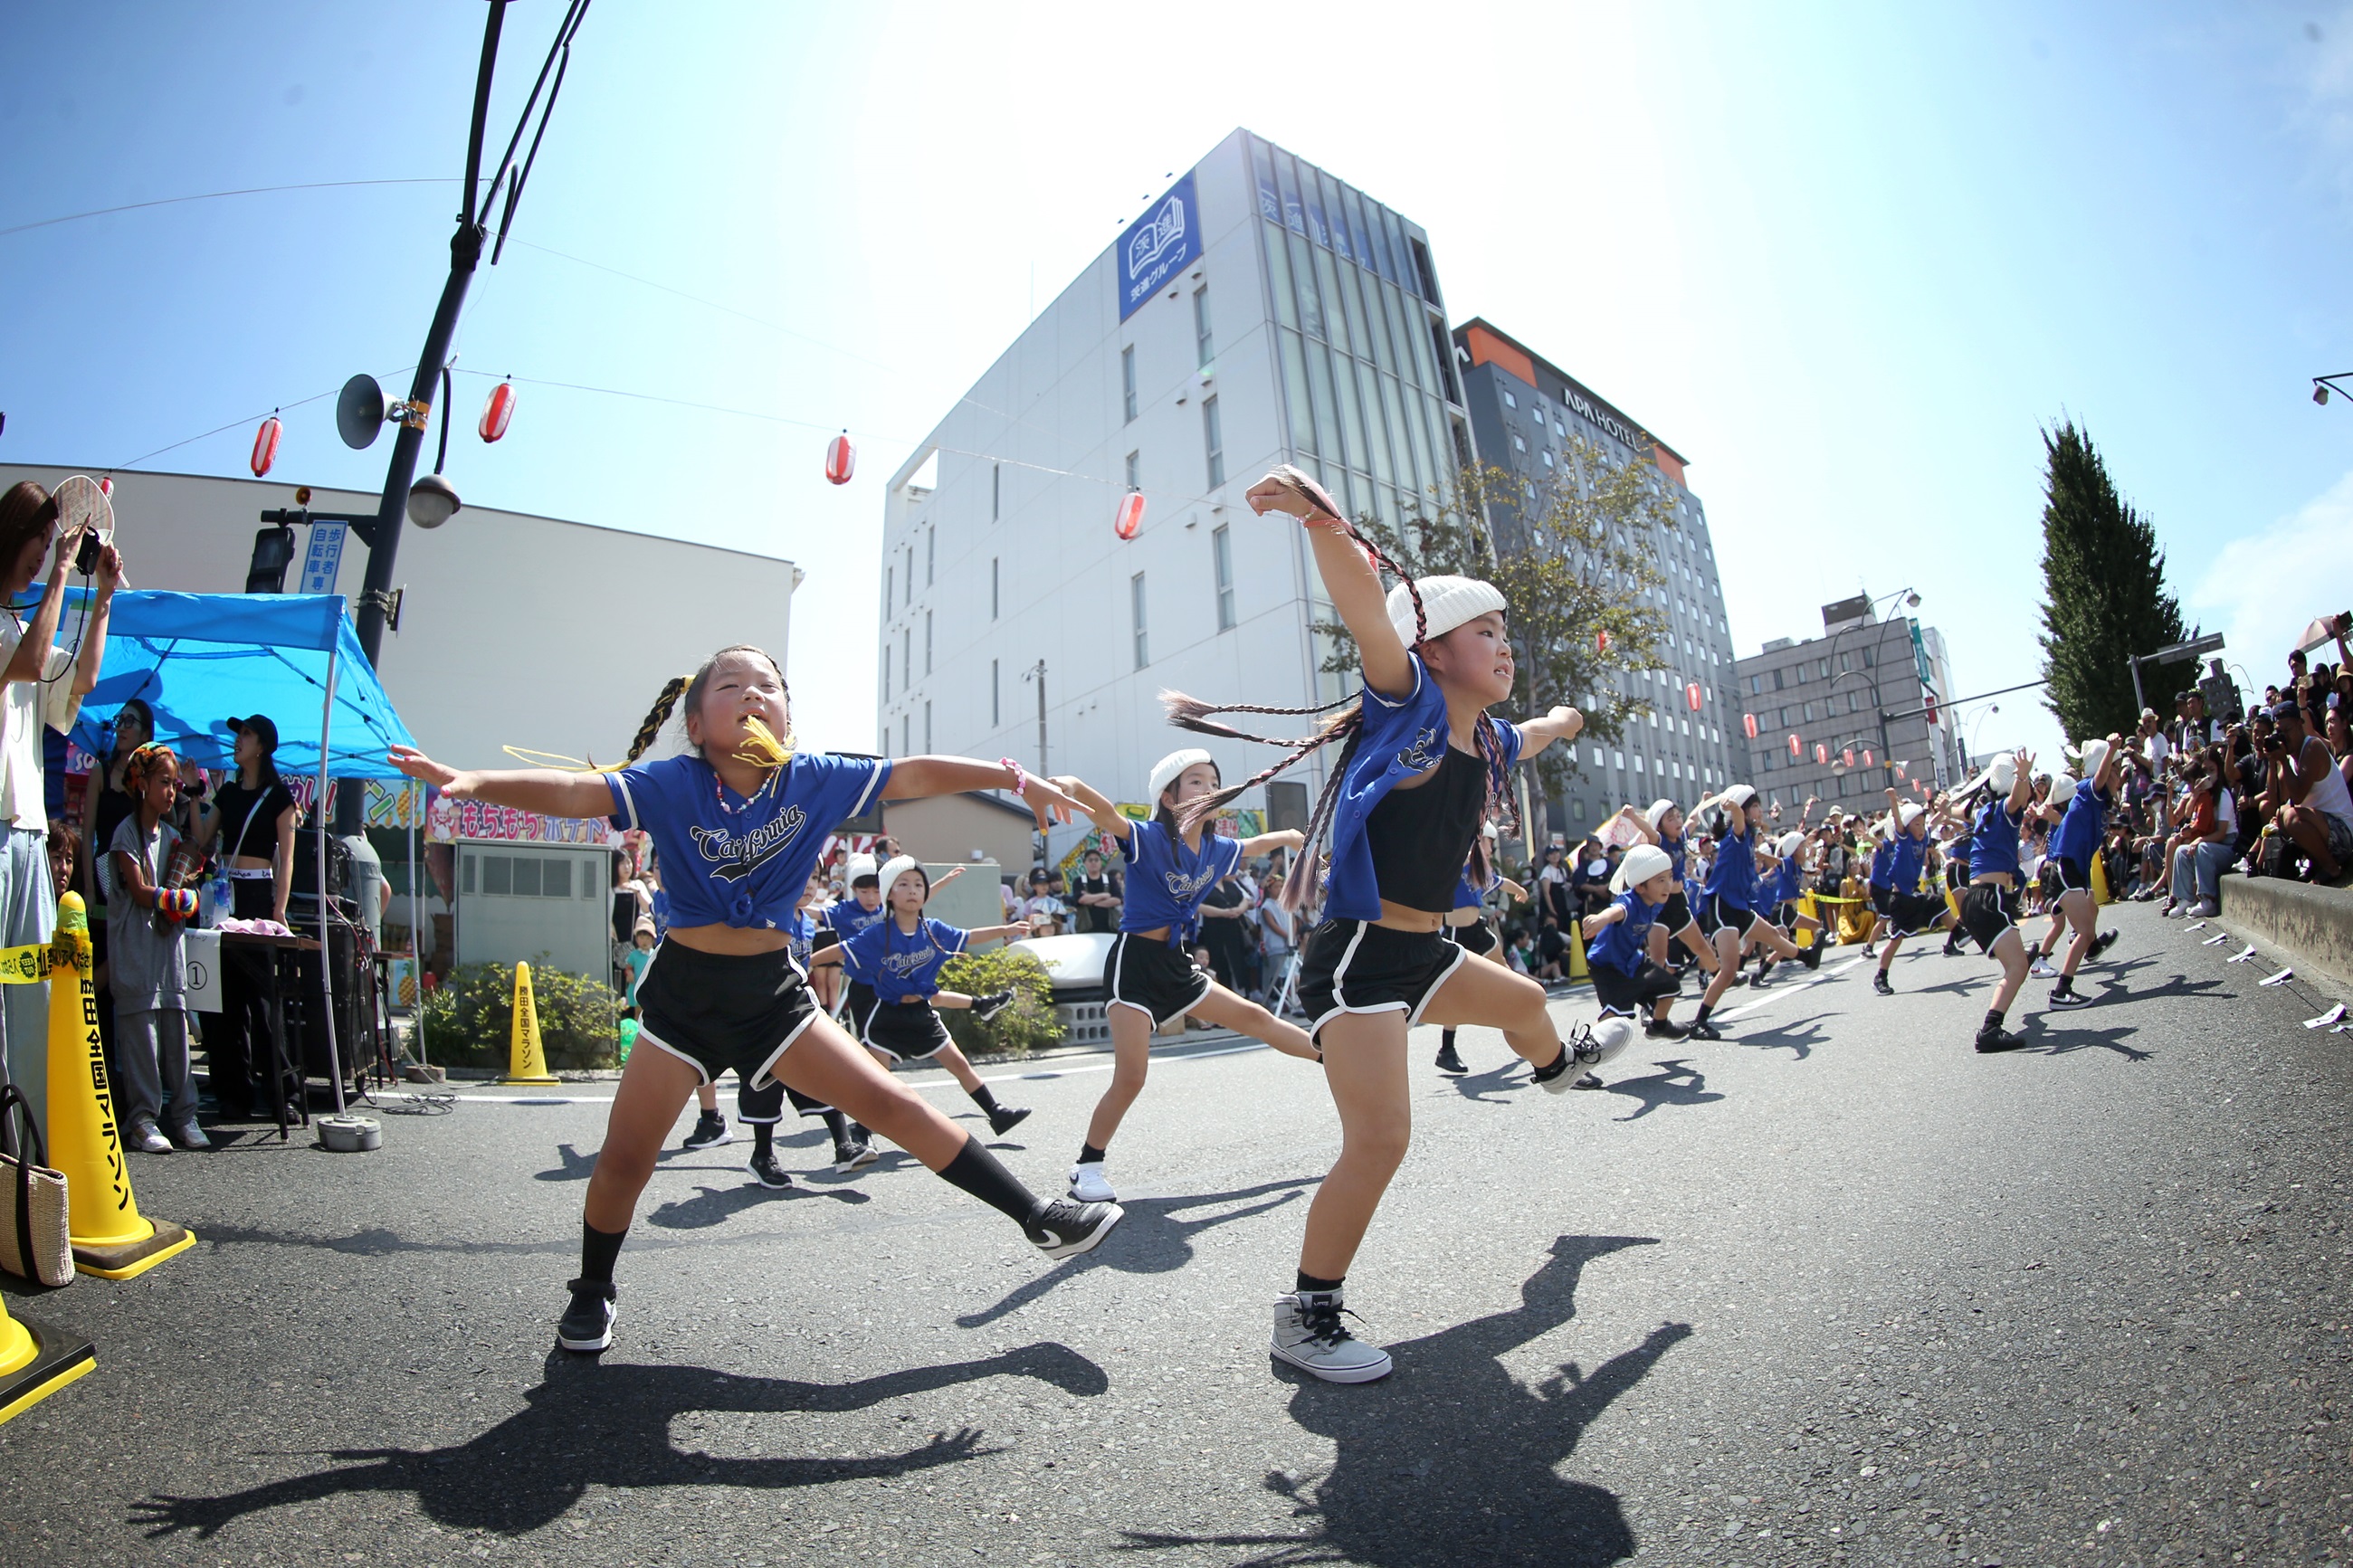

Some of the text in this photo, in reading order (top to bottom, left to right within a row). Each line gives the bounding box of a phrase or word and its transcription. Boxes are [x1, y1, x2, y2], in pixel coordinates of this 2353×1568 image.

[1564, 387, 1640, 452] APA HOTEL
[308, 528, 327, 574] 自転車
[326, 528, 341, 575] 歩行者
[519, 985, 532, 1069] 勝田全国マラソン
